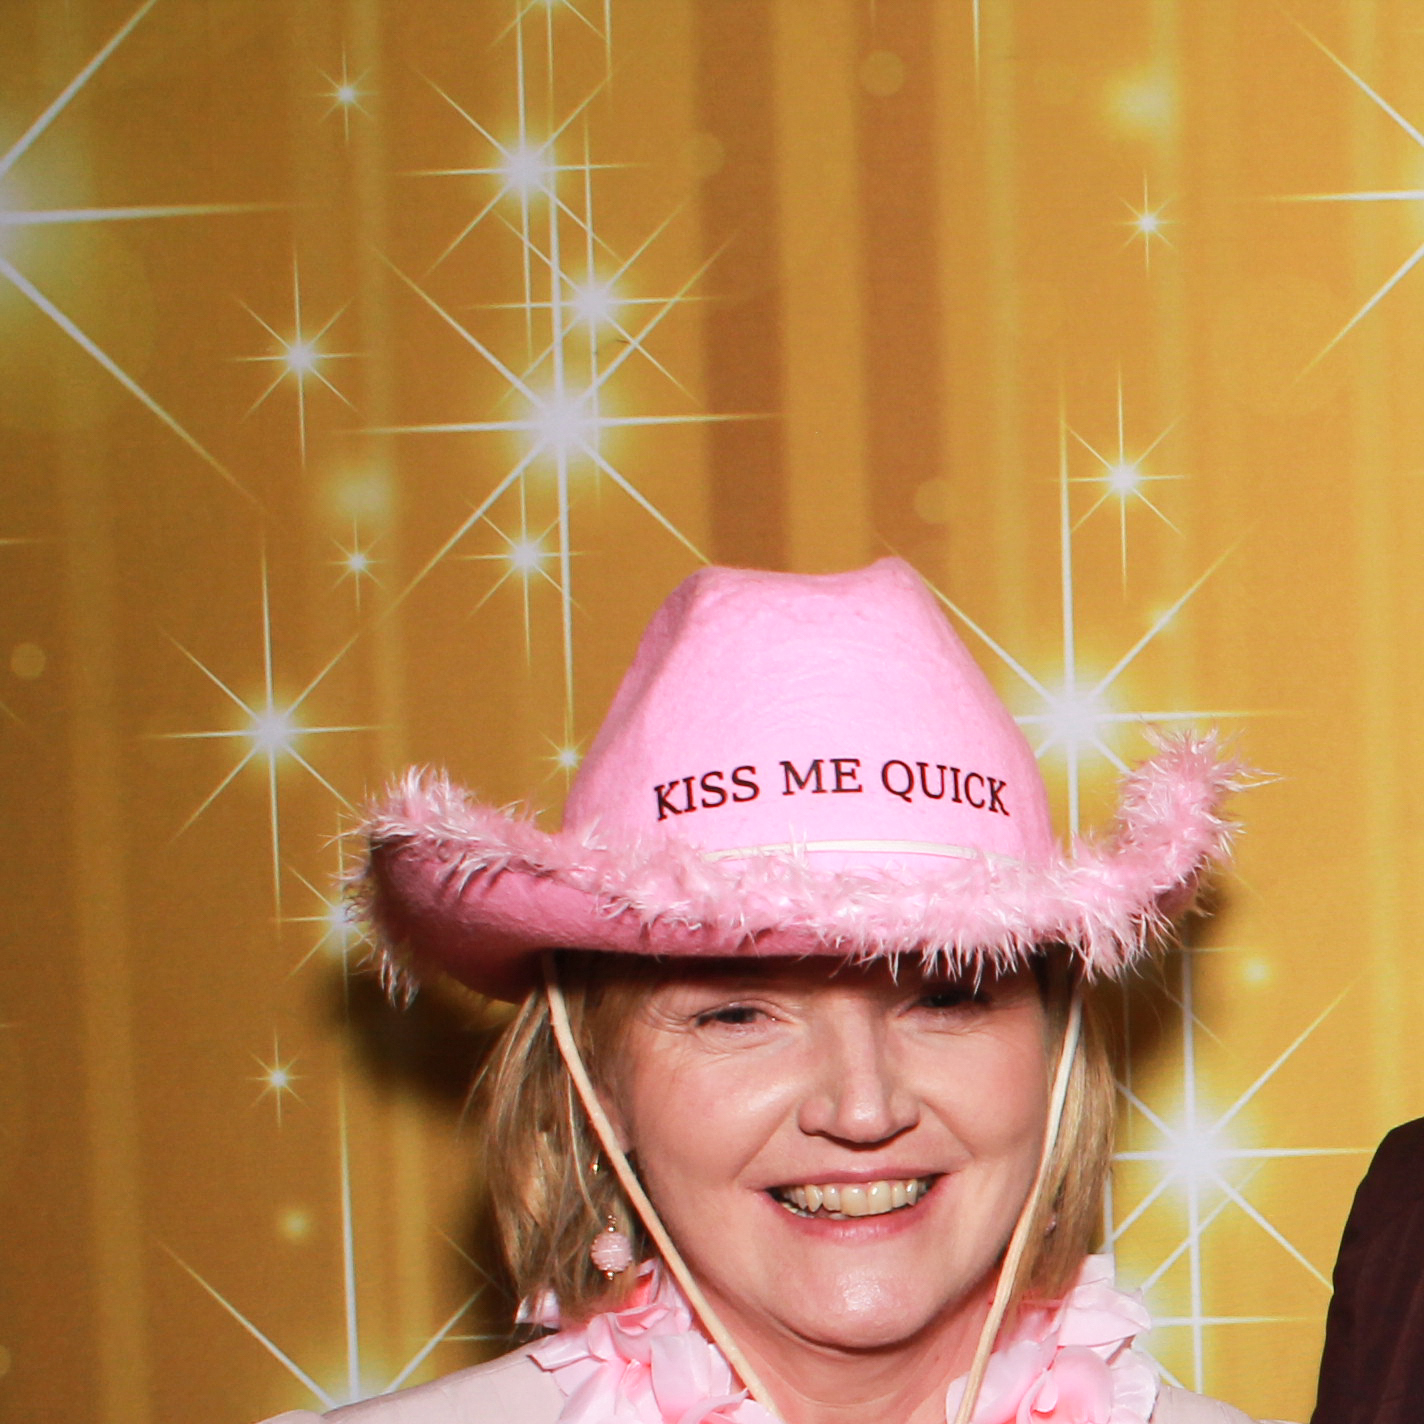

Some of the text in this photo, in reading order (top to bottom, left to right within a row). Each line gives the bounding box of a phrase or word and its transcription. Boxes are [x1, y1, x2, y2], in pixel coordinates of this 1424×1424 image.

[653, 758, 1010, 821] KISS ME QUICK
